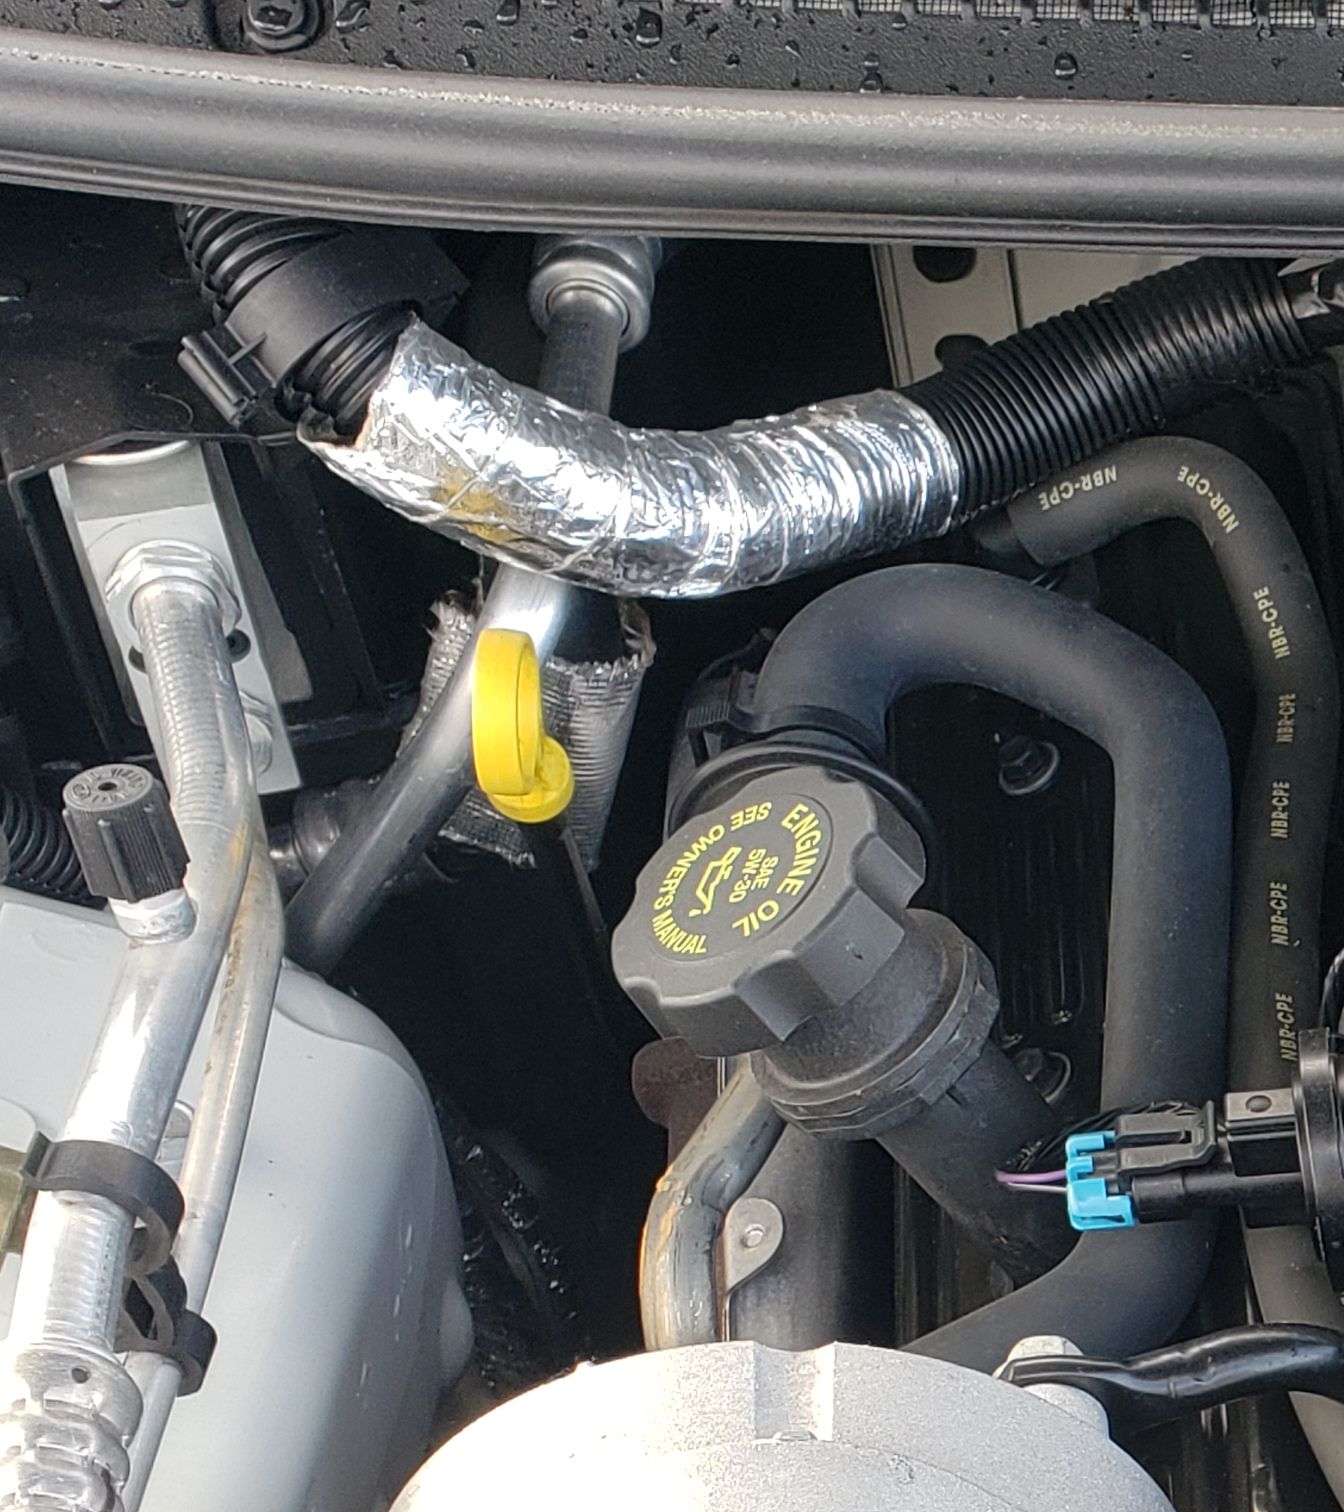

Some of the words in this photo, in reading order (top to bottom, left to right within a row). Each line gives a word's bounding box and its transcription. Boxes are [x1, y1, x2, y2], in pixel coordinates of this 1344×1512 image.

[1038, 464, 1118, 511] NBR-CPE
[1177, 465, 1240, 534] NBR-CPE
[1253, 586, 1291, 660] NBR-CPE
[1276, 693, 1296, 743] NBR-CPE
[730, 802, 772, 831] SEE
[1270, 780, 1290, 840] NBR-CPE
[729, 848, 767, 904] 5W-30
[750, 856, 779, 891] SAE
[777, 803, 822, 896] ENGINE
[652, 909, 708, 954] MANUAL
[731, 899, 780, 937] OIL
[1270, 881, 1289, 946] NBR-CPE
[1280, 992, 1298, 1062] NBR-CPE
